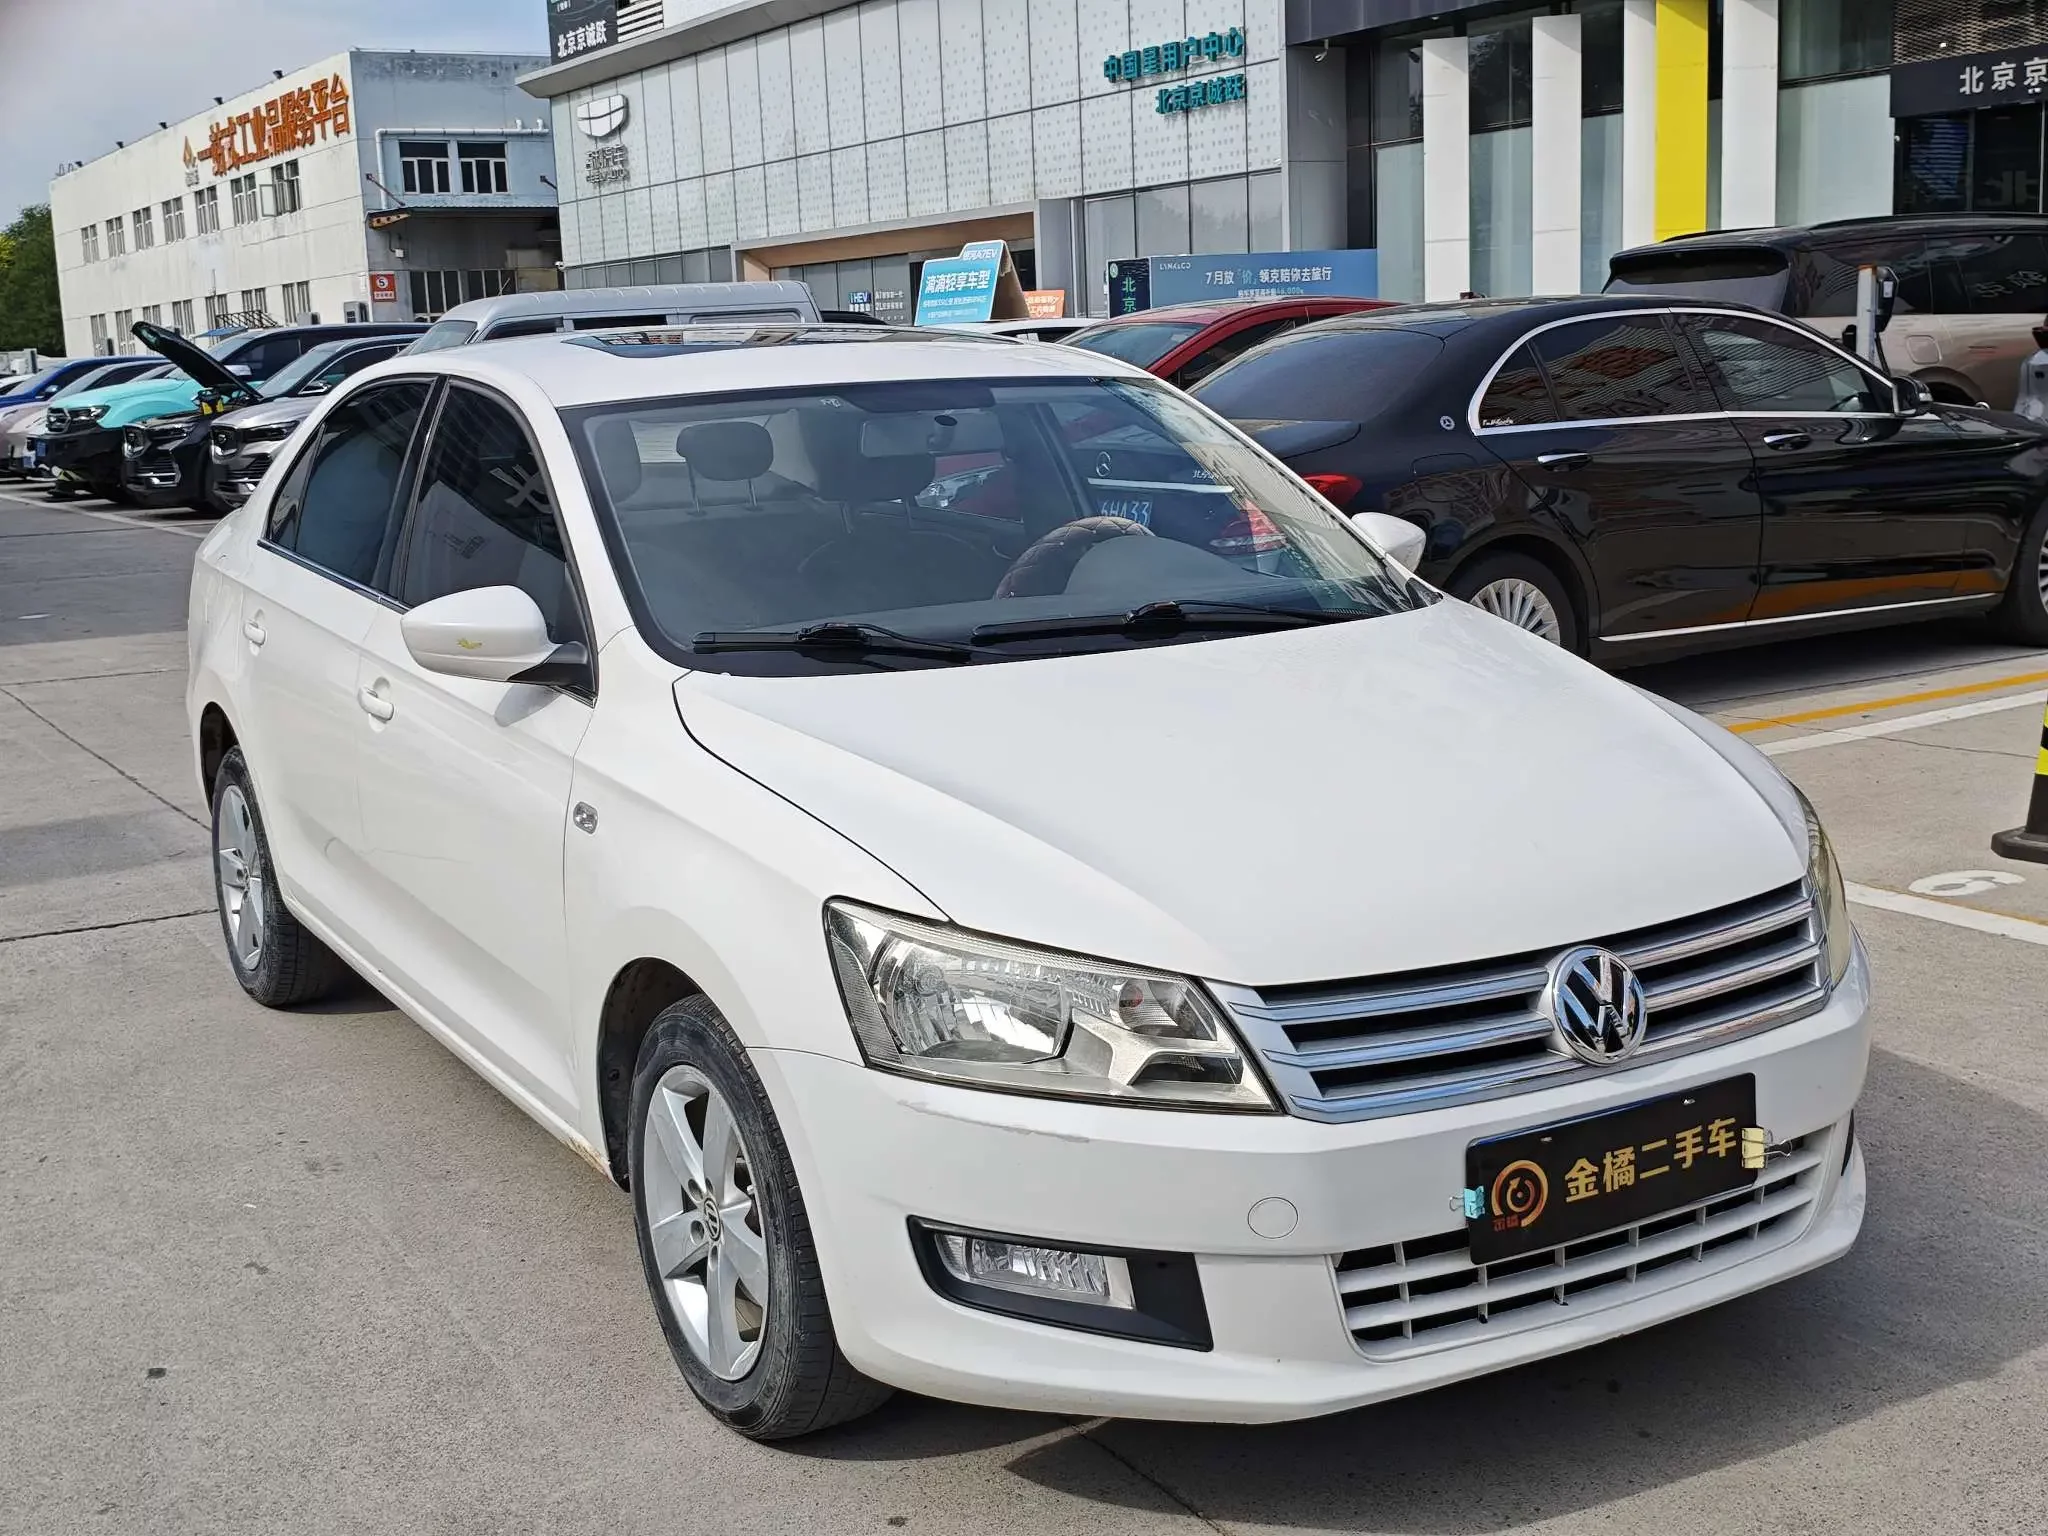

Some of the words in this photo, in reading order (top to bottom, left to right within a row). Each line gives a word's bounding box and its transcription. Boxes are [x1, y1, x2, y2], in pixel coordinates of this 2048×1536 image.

[557, 20, 607, 58] 北京京诚跃
[1103, 26, 1244, 83] 中国星用户中心
[1155, 73, 1245, 114] 北京京诚跃
[197, 72, 350, 177] 一站式工业品服务平台
[925, 270, 991, 294] 滴滴轻享车型
[1122, 276, 1137, 312] 北京
[1564, 1116, 1738, 1203] 金橘二手车
